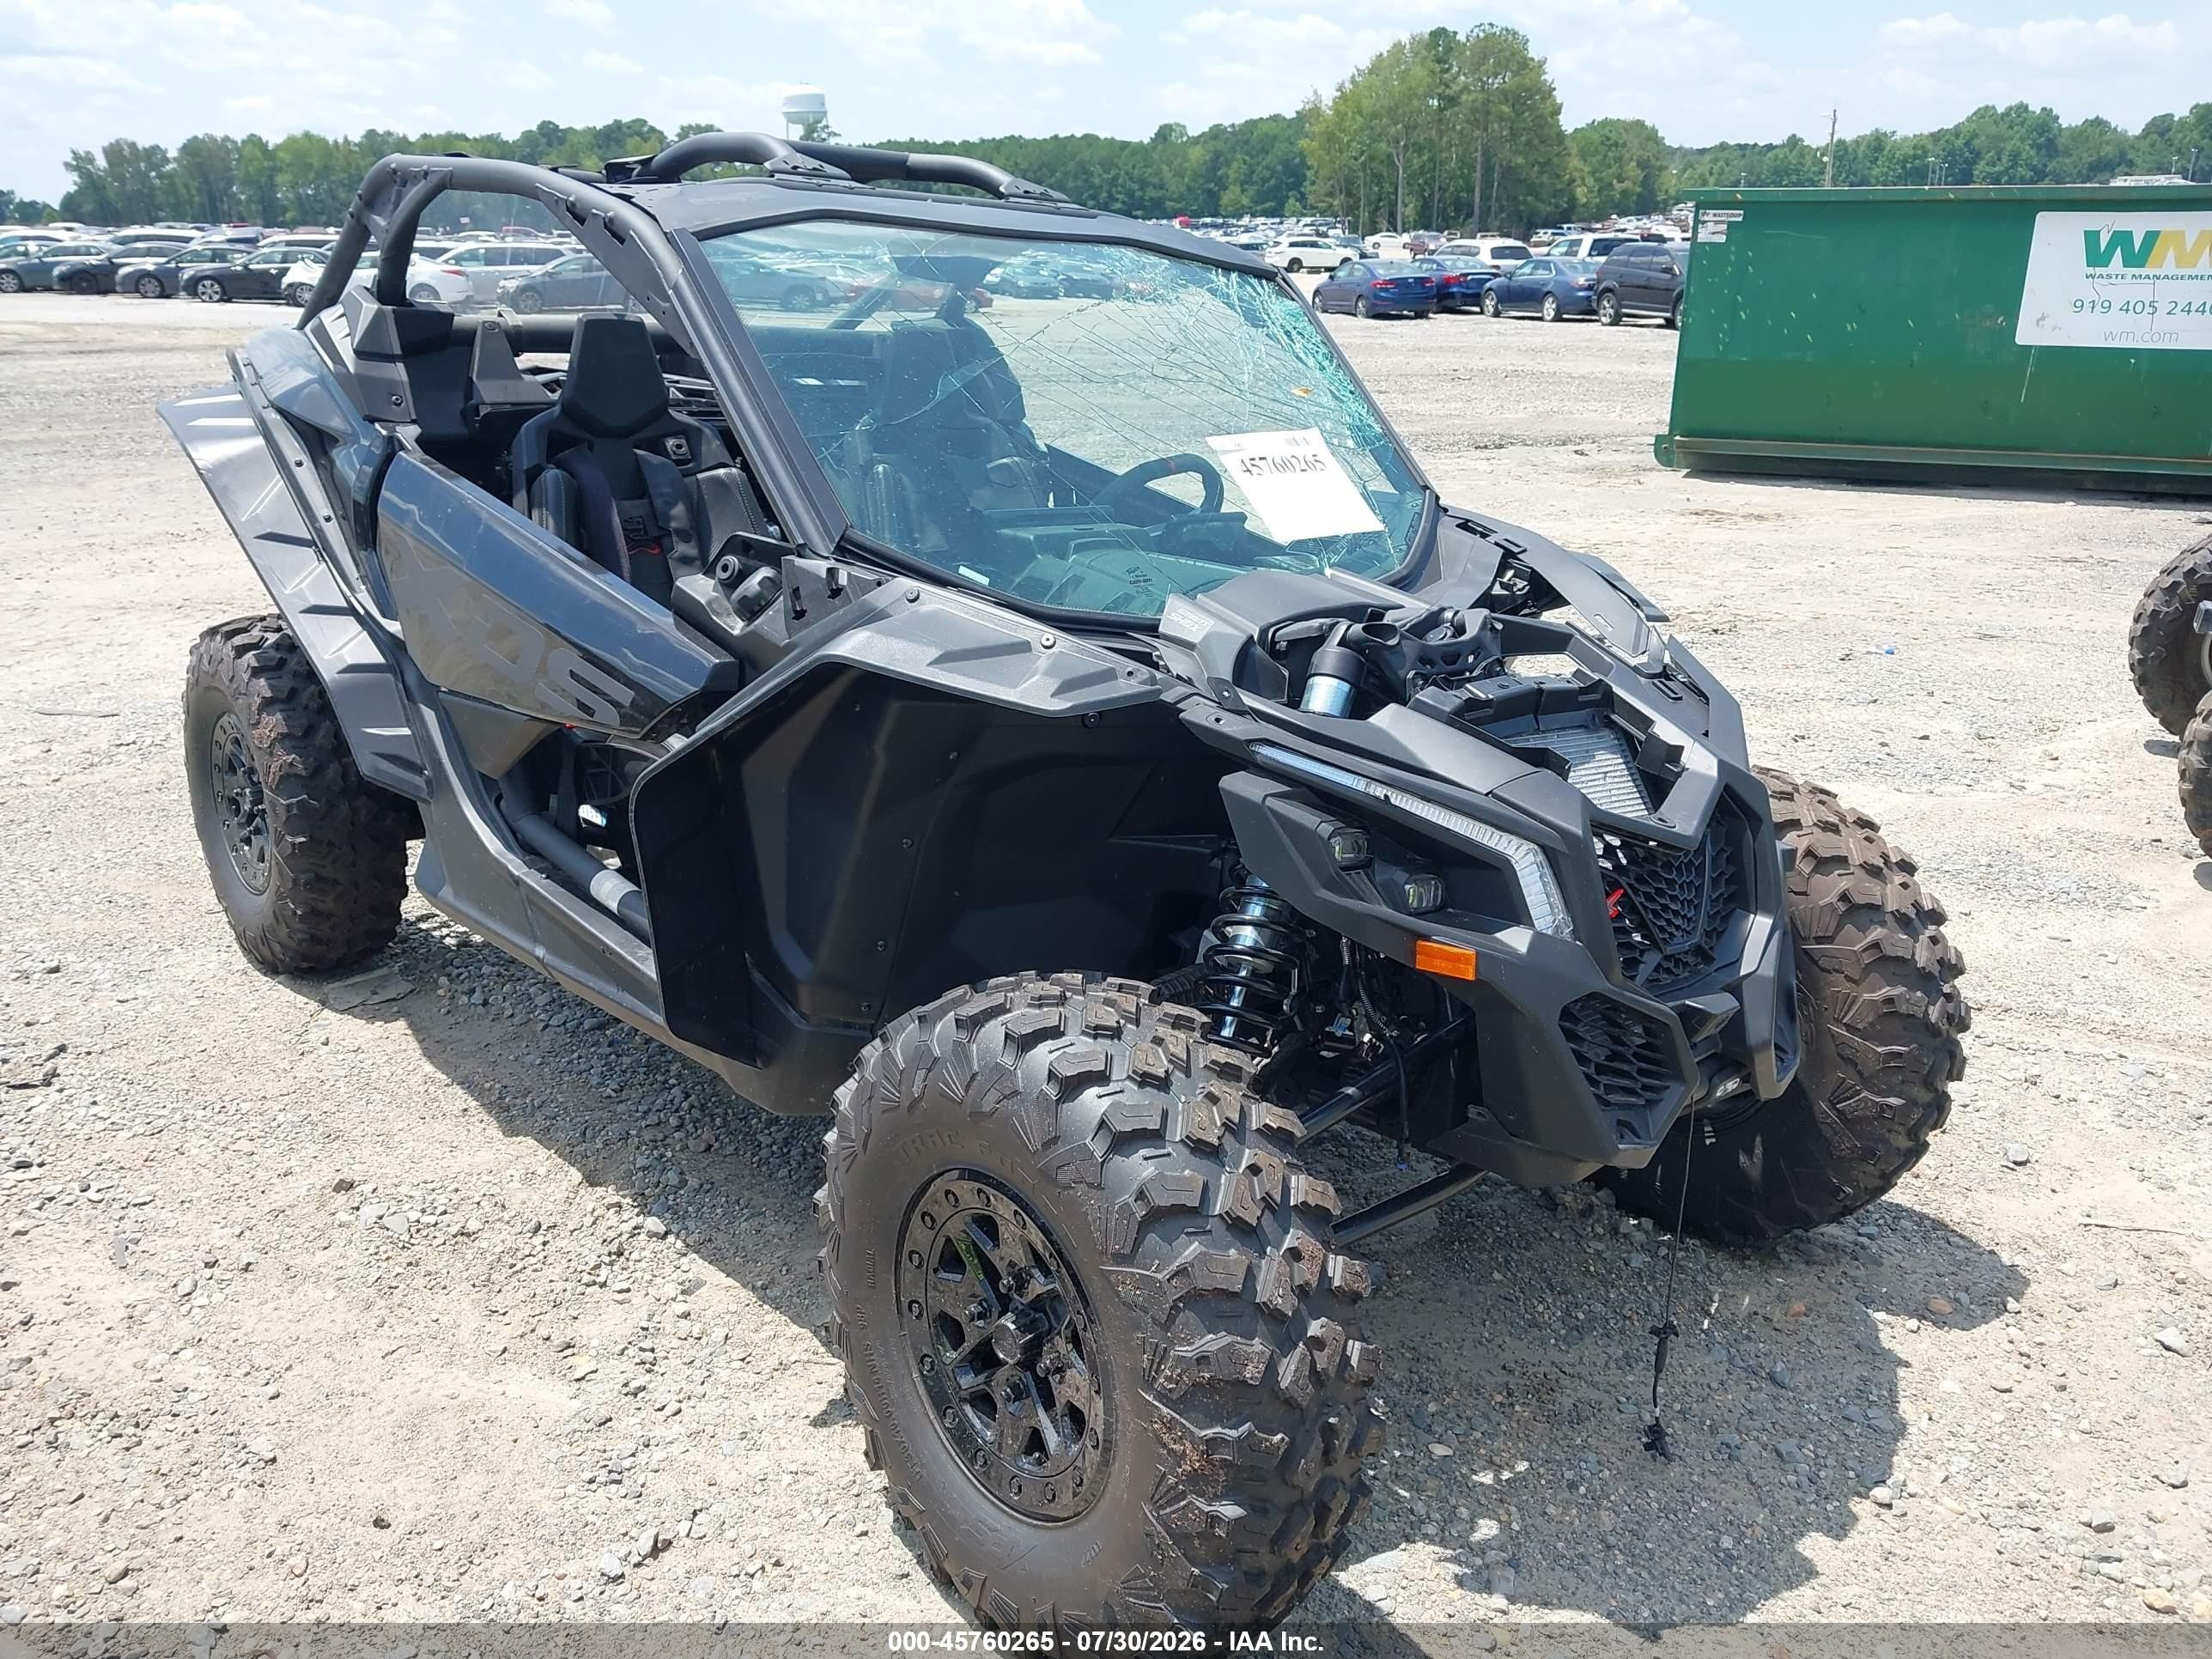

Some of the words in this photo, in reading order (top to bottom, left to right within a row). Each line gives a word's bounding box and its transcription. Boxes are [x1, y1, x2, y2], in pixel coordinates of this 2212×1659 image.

[2084, 230, 2212, 269] WM
[2073, 299, 2112, 314] 919
[2118, 300, 2159, 315] 405
[2104, 331, 2179, 343] wm.com
[1240, 453, 1328, 476] 45760265
